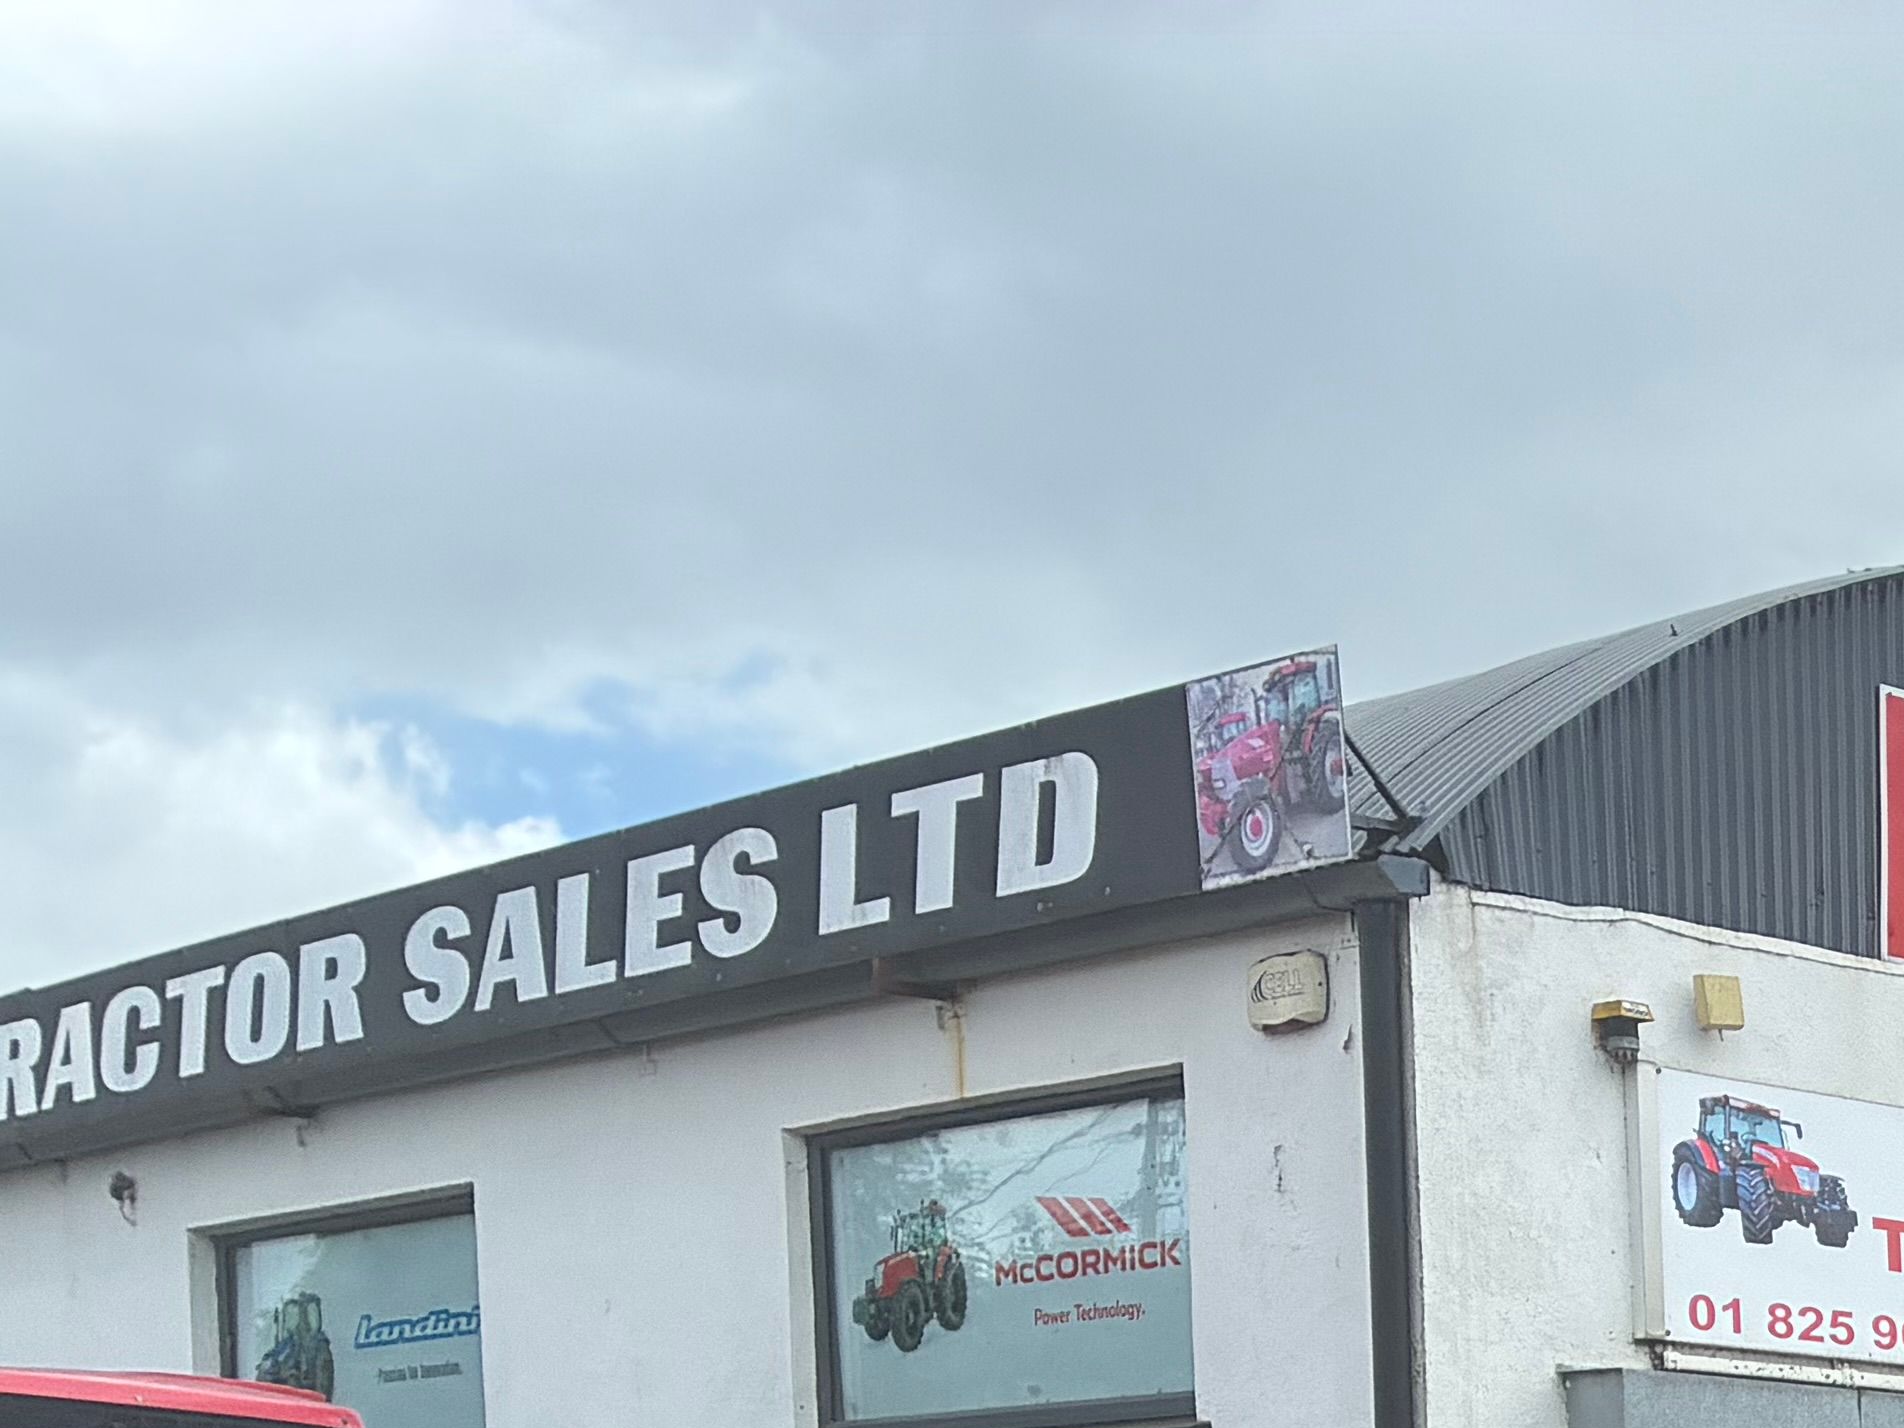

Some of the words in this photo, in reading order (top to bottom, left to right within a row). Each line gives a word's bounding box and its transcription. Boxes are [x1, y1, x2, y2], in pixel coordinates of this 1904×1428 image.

[402, 827, 779, 1026] SALES
[818, 751, 1099, 937] LTD
[994, 1238, 1182, 1287] McCORMICK
[1033, 1306, 1071, 1327] Power
[1689, 1295, 1743, 1335] 01
[1767, 1303, 1855, 1347] 825
